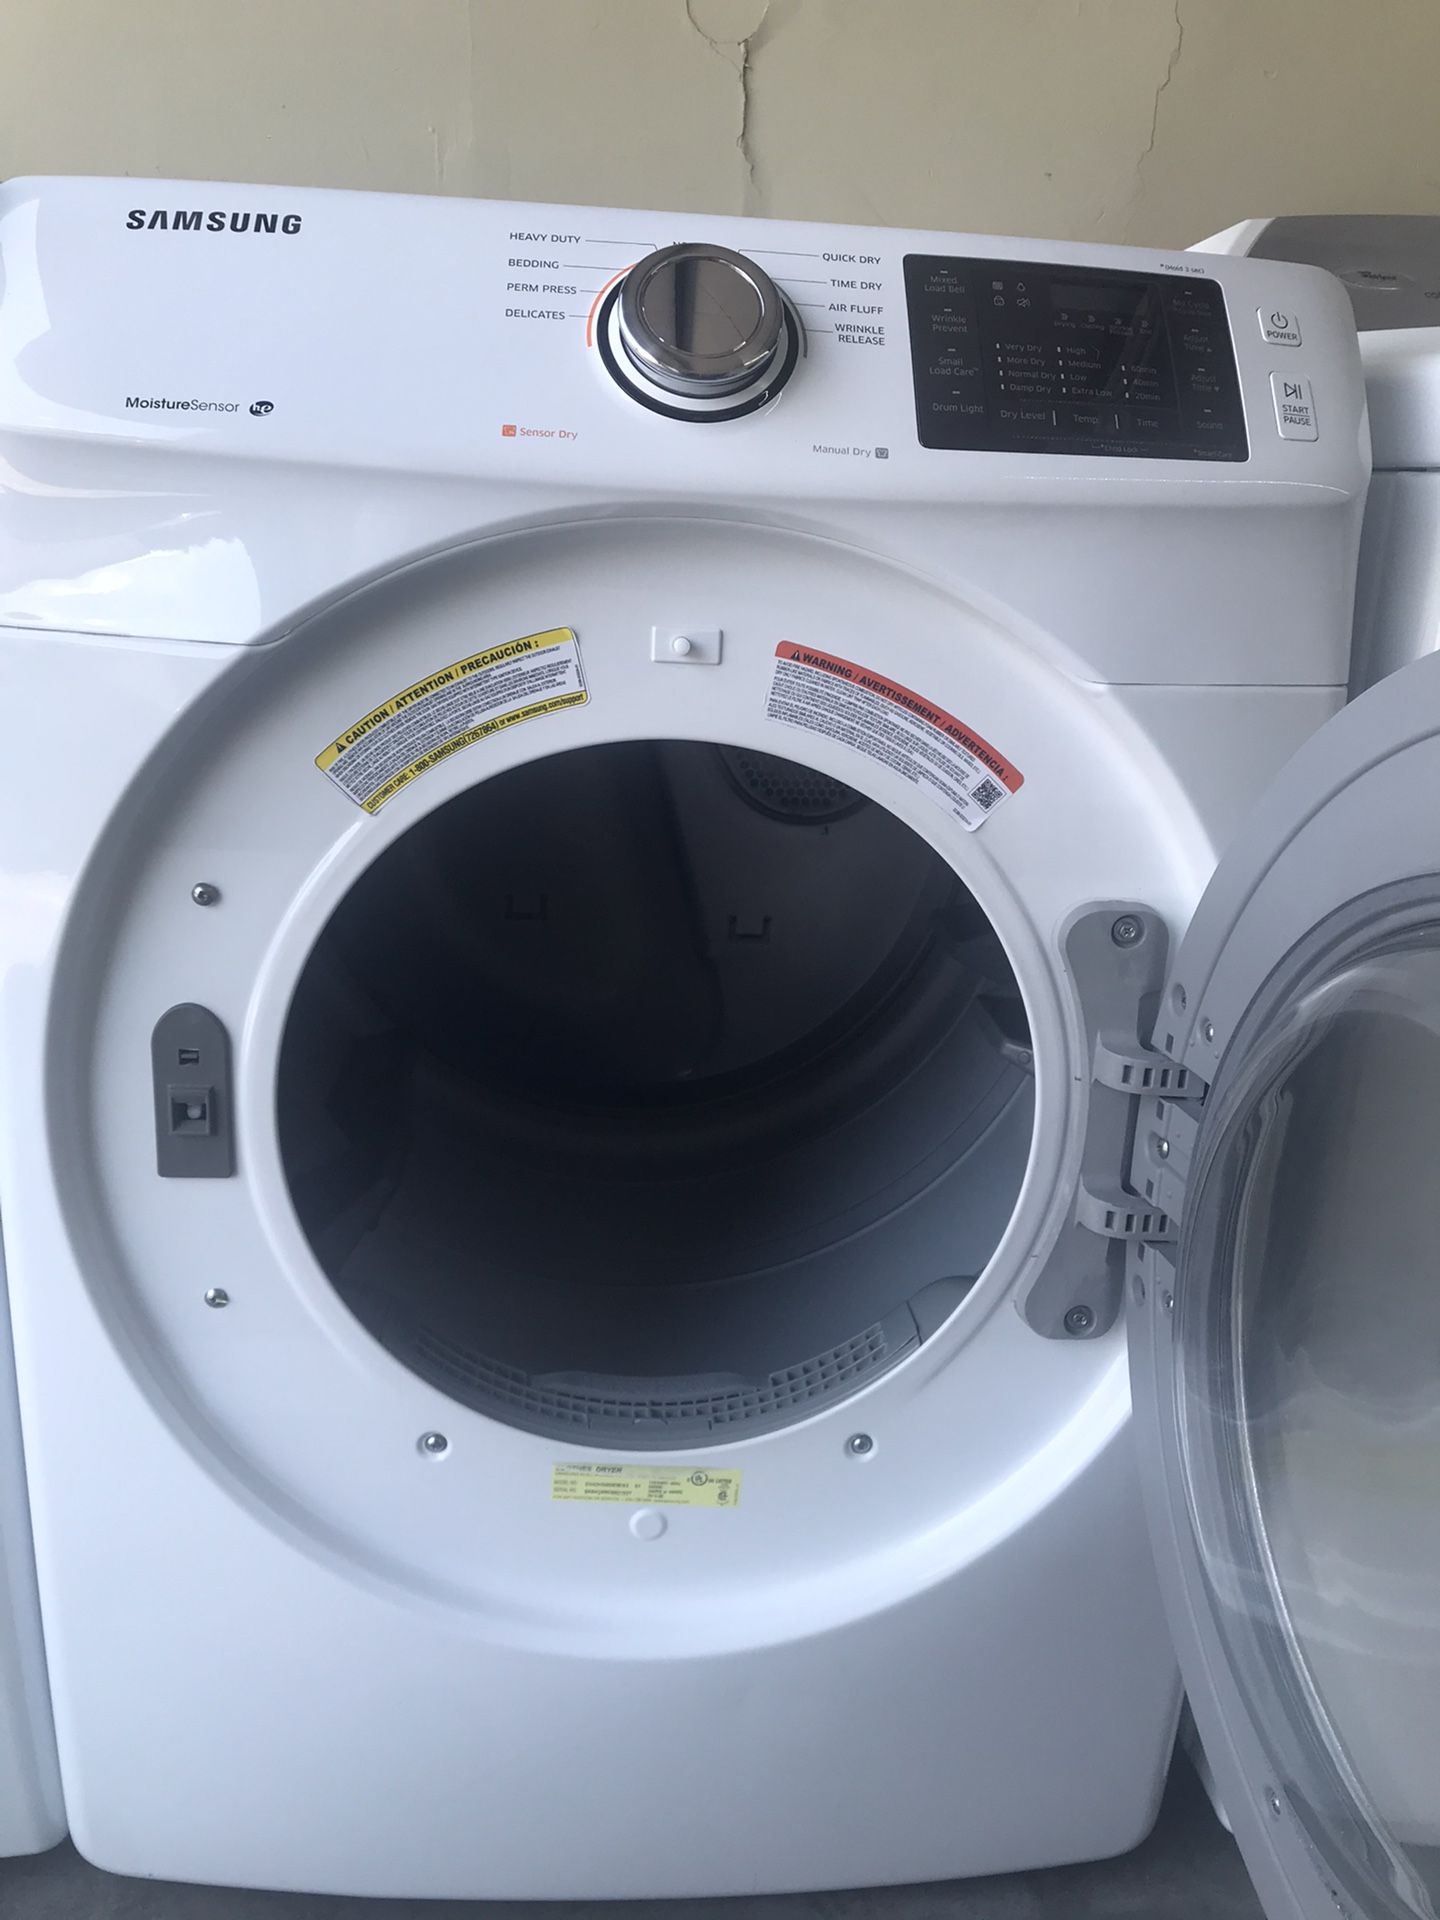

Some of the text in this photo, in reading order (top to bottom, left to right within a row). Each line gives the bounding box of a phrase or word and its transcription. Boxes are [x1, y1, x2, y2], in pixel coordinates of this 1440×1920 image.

[126, 208, 303, 235] SAMSUNG
[509, 231, 582, 245] HEAVY DUTY
[508, 258, 560, 270] BEDDING
[822, 252, 882, 265] QUICK DRY
[829, 279, 882, 291] TIME DRY
[929, 275, 958, 285] Mixed
[506, 282, 577, 295] PERM PRESS
[924, 284, 966, 294] Load Bell
[505, 308, 566, 321] DELICATES
[828, 302, 884, 315] AIR FLUFF
[931, 314, 967, 324] Wrinkle
[834, 323, 885, 335] WRINKLE
[932, 324, 968, 334] Prevent
[1266, 329, 1298, 341] POWER
[838, 334, 886, 346] RELEASE
[1004, 342, 1043, 354] Very Dry
[1066, 346, 1087, 356] High
[937, 356, 963, 366] Small
[1007, 356, 1046, 368] More Dry
[1068, 359, 1102, 370] Medium
[929, 367, 951, 376] Load
[1008, 369, 1057, 381] Normal Dry
[1070, 373, 1088, 382] Low
[1009, 383, 1053, 394] Damp Dry
[1071, 386, 1113, 397] Extra Low
[1134, 391, 1161, 402] 20min
[125, 396, 240, 413] MoistureSensor
[932, 402, 984, 414] Drum Light
[1282, 404, 1309, 415] START
[1000, 409, 1047, 421] Dry Level
[1283, 415, 1311, 426] PAUSE
[1136, 418, 1160, 428] Time
[1195, 420, 1224, 431] Sound
[519, 427, 578, 441] Sensor Dry
[812, 443, 872, 459] Manual Dry
[345, 708, 390, 745] CAUTION
[395, 671, 454, 710] ATTENTION
[460, 639, 532, 675] PRECAUCIÓN
[803, 653, 853, 679] WARNING
[859, 675, 940, 727] AVERTISSEMENT
[944, 724, 1004, 778] ADVERTENCIA
[366, 783, 395, 809] CUSTOMER
